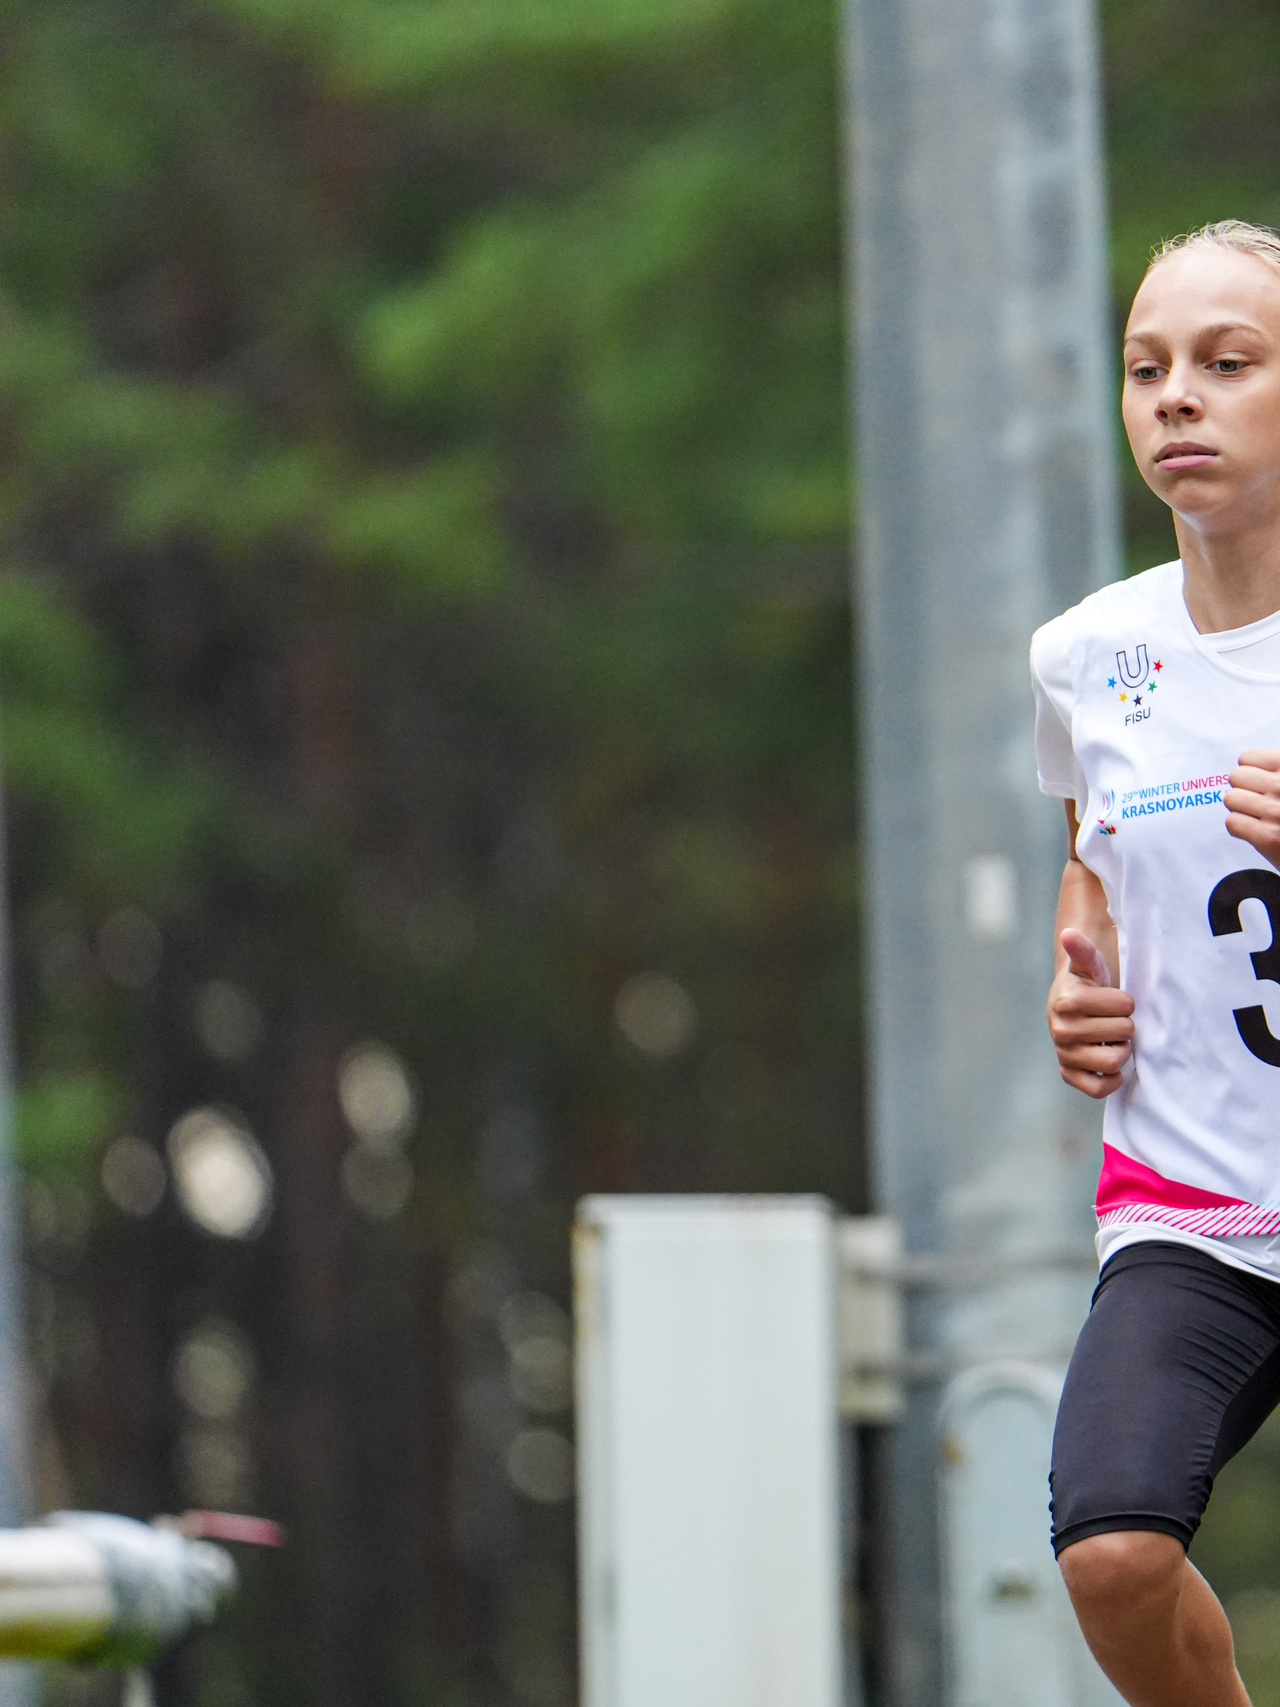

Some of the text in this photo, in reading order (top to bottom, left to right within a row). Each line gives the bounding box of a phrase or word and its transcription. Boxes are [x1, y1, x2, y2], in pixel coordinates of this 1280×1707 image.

[1125, 707, 1151, 726] FISU
[1139, 783, 1180, 799] WINTER
[1122, 791, 1222, 819] KRASNOYARSK
